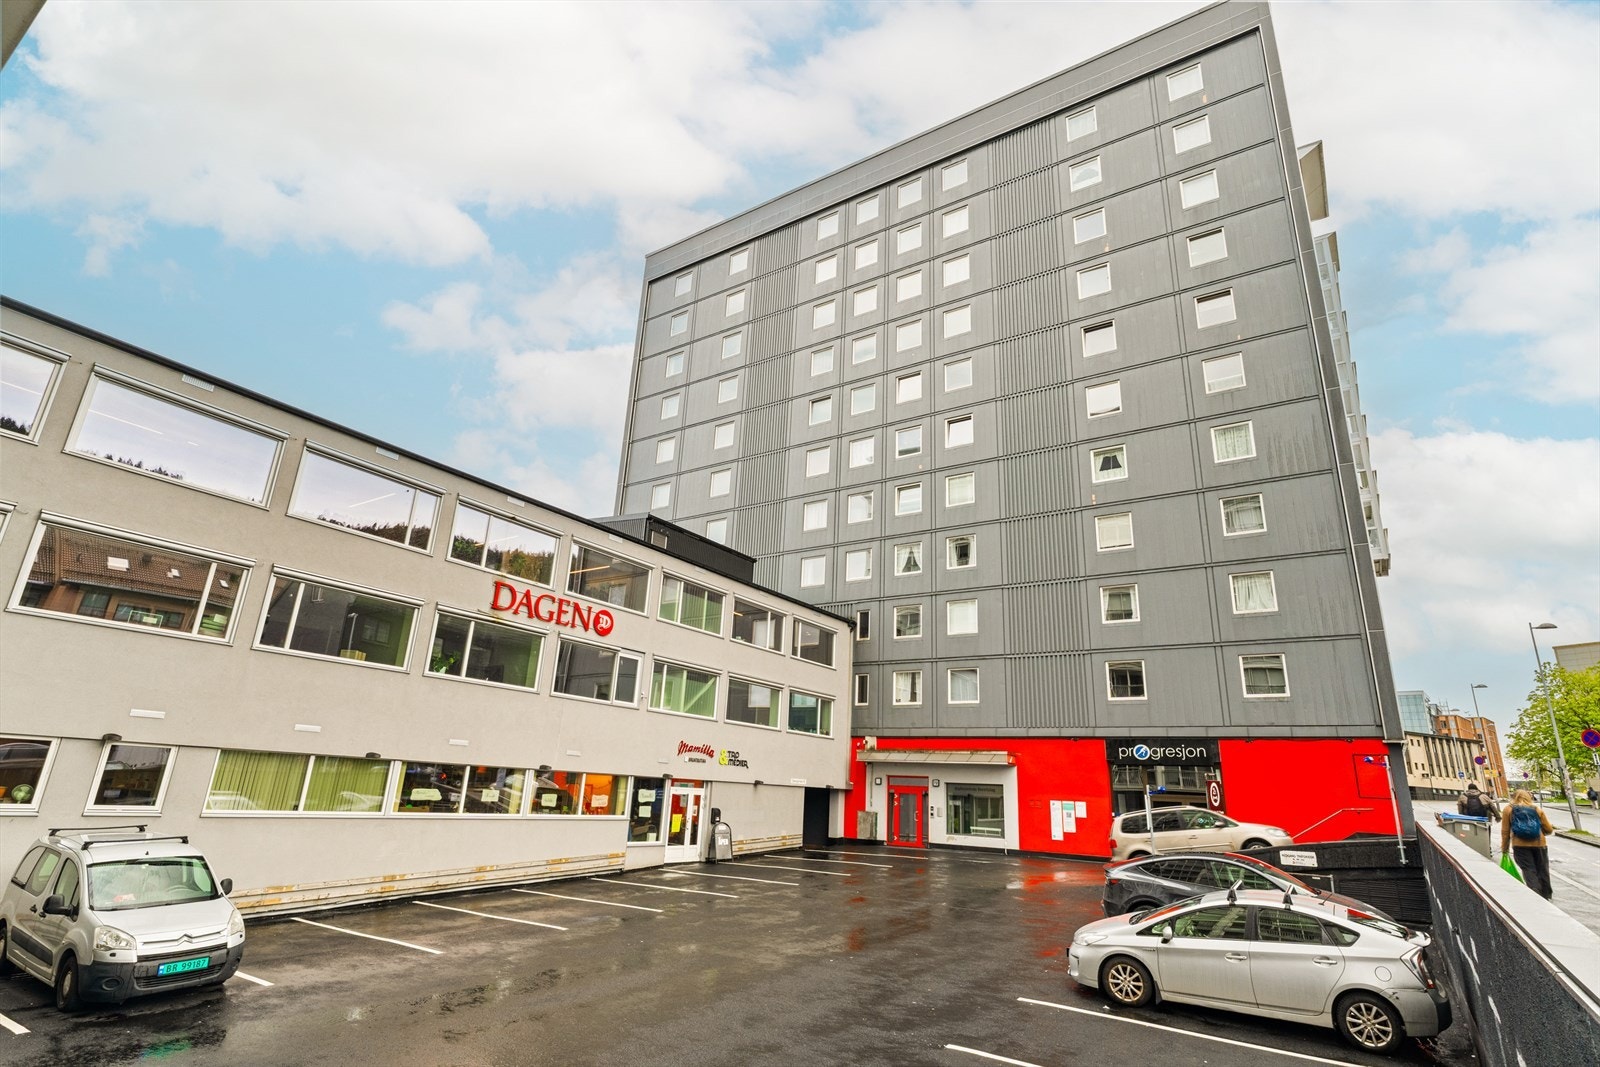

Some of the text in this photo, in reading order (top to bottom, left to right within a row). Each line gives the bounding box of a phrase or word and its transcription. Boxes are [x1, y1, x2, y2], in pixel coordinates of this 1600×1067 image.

[491, 581, 592, 632] DAGEN
[677, 740, 715, 759] Mamilla
[1119, 744, 1206, 760] progresjon
[166, 960, 206, 973] BR 99187
